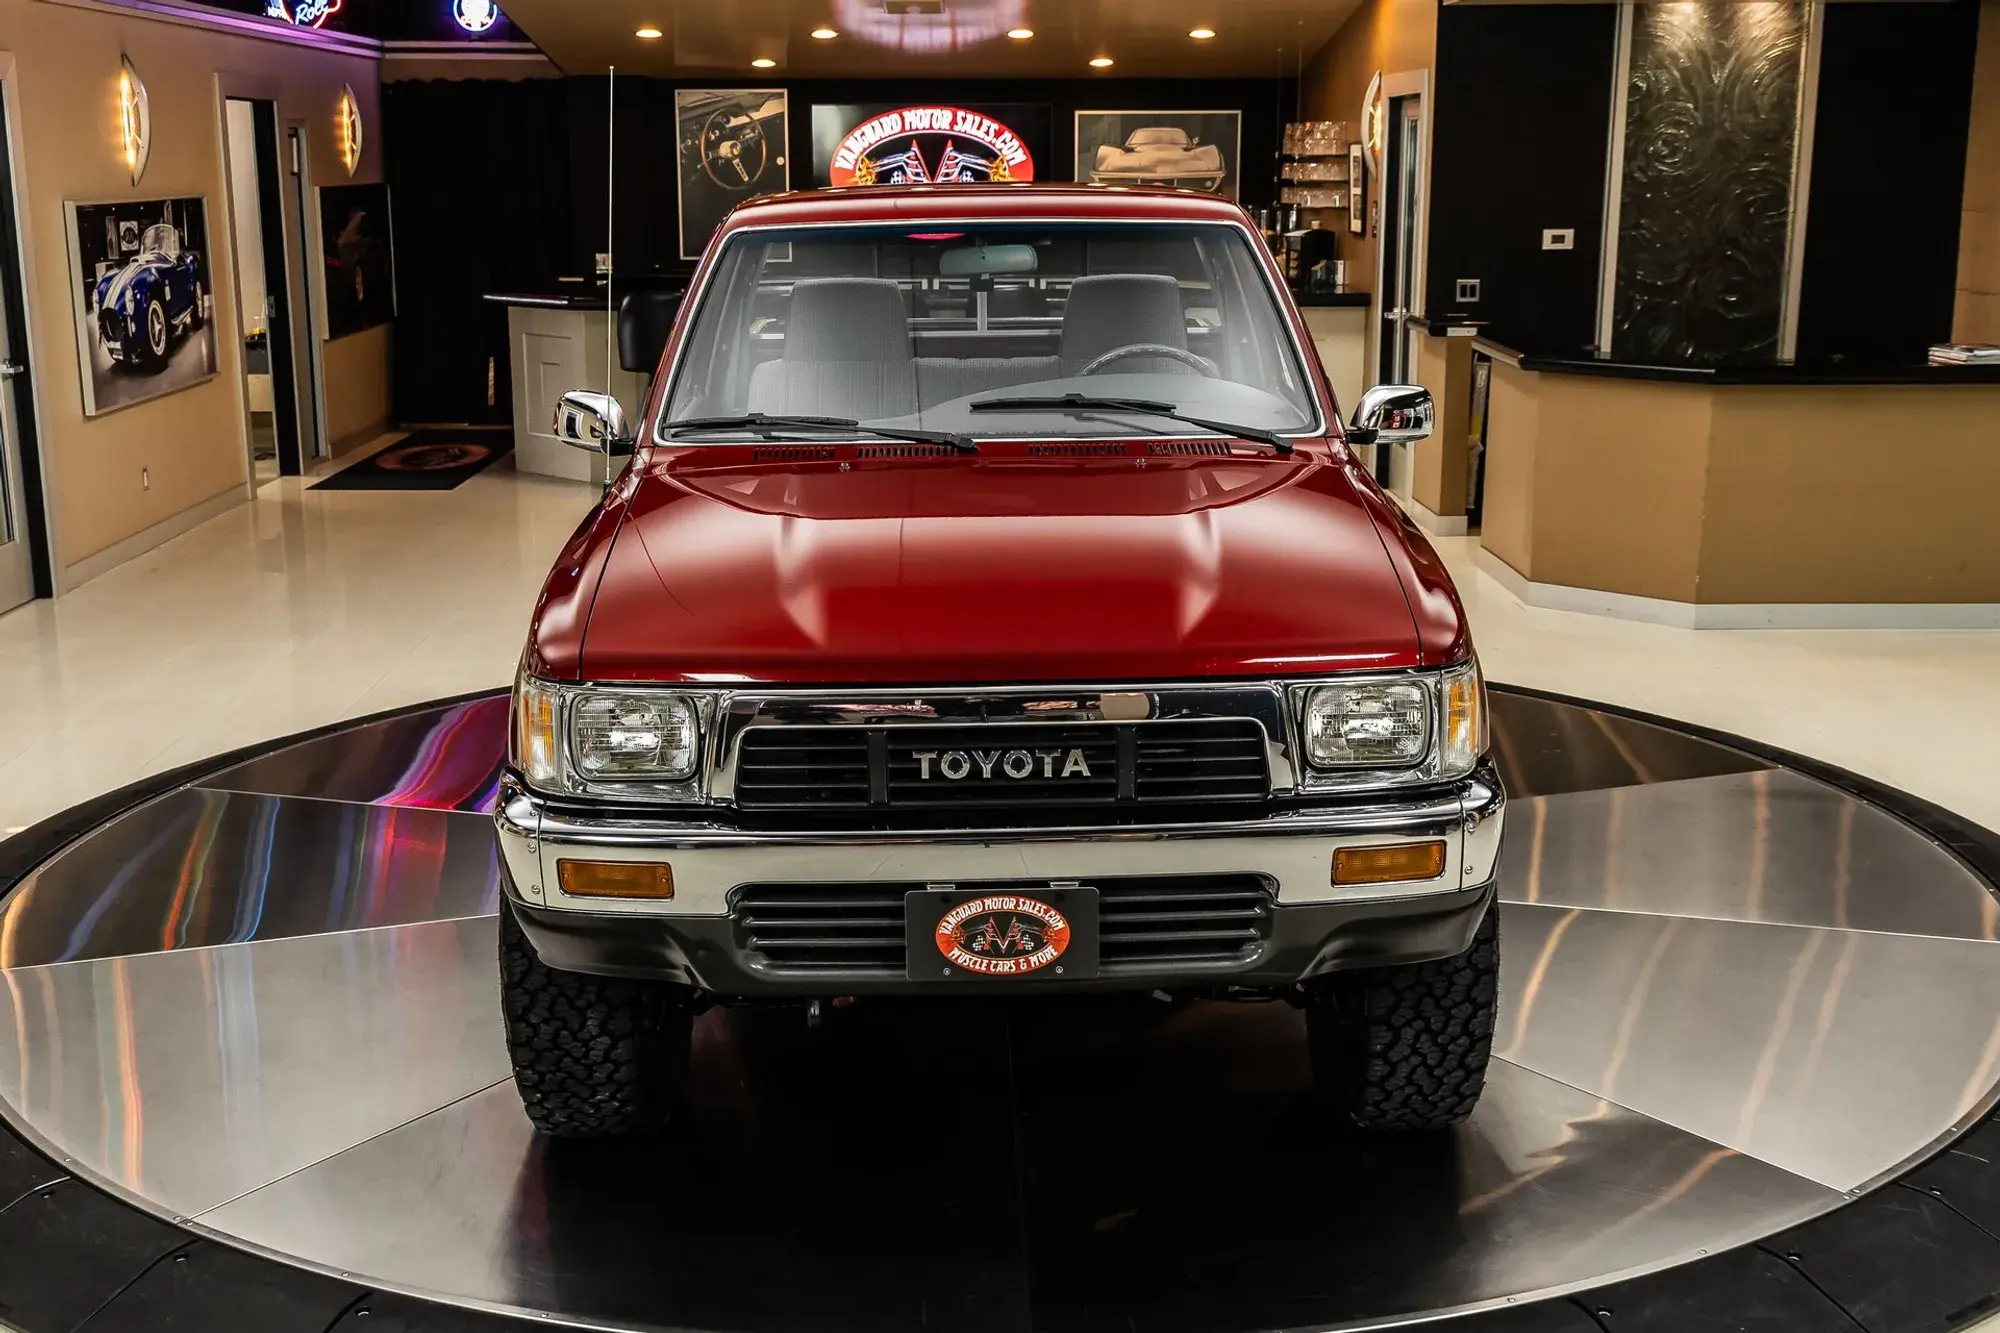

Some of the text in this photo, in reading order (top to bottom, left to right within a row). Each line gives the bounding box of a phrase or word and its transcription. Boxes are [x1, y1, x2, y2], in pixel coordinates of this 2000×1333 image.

[834, 108, 1027, 171] VANGUARD MOTOR SALES.COM
[912, 749, 1091, 780] TOYOTA
[938, 897, 1066, 935] VANGUARD MOTOR SALES.COM
[947, 944, 1059, 973] MUSCLE CARS & MORE
